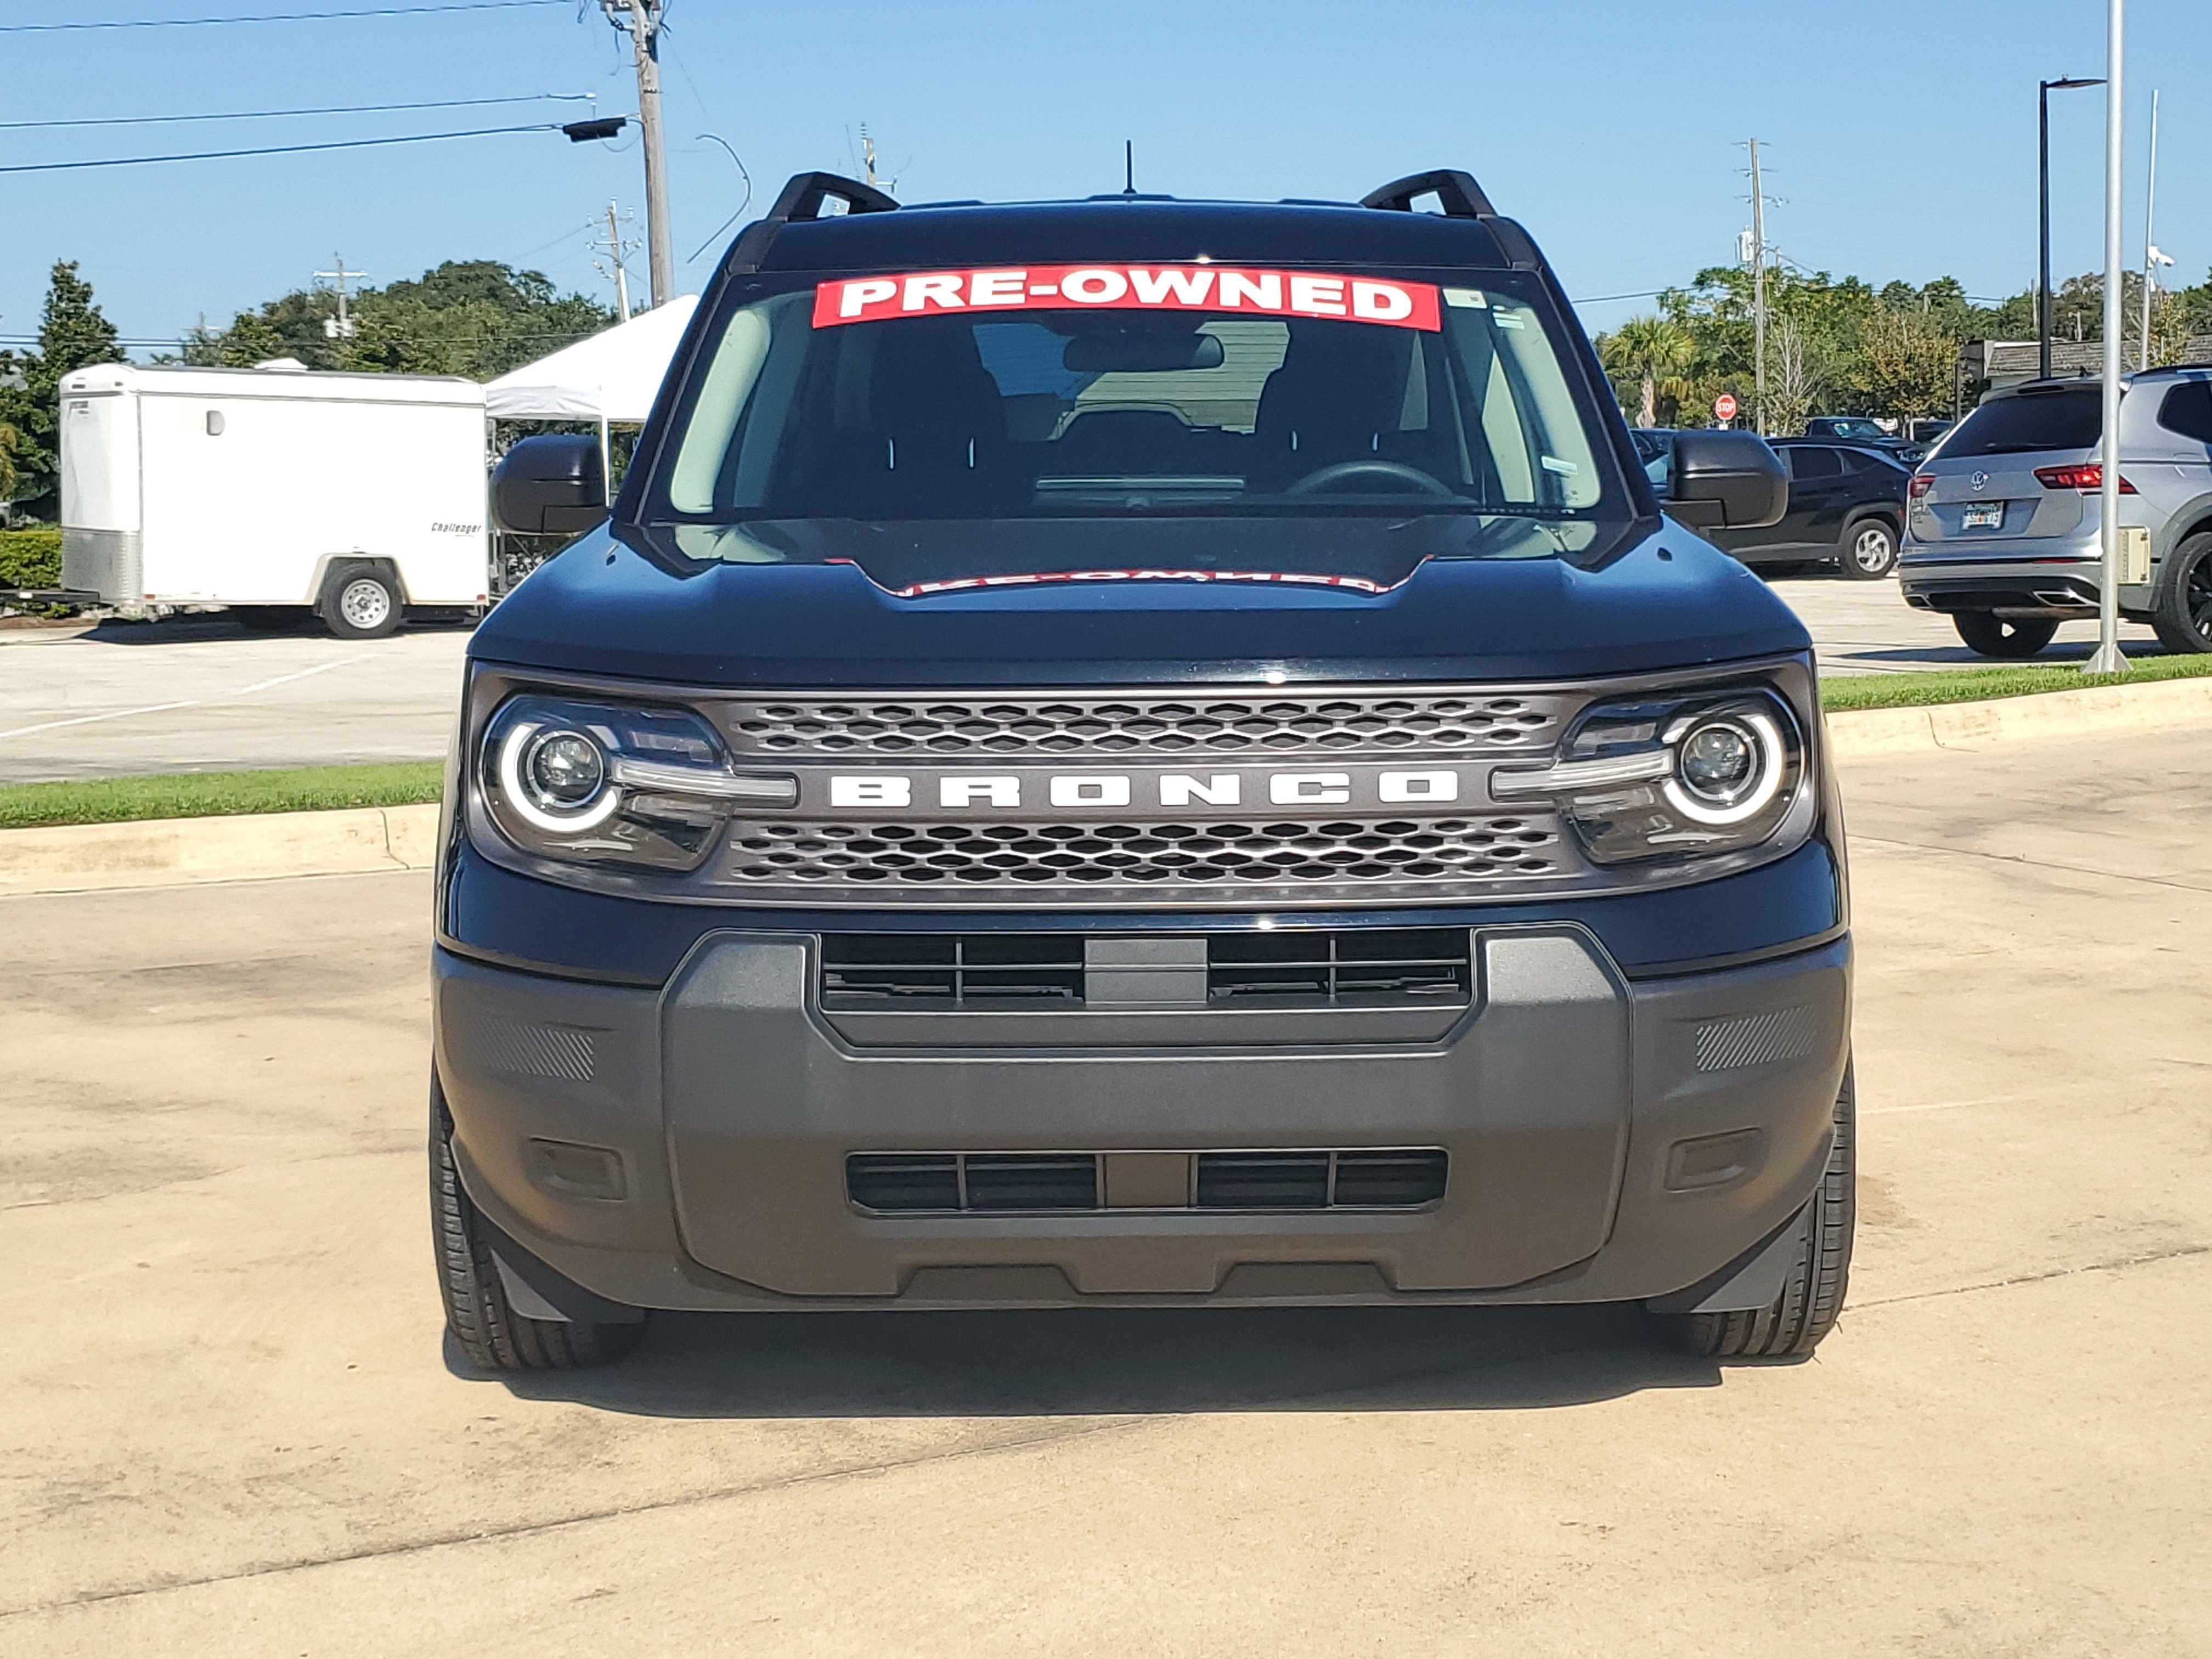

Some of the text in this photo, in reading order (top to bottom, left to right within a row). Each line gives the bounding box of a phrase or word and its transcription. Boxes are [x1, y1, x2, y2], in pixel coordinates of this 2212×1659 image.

[839, 269, 1412, 320] PRE-OWNED
[1717, 402, 1734, 413] STOP
[431, 522, 482, 534] Challenger
[831, 771, 1458, 807] BRONCO
